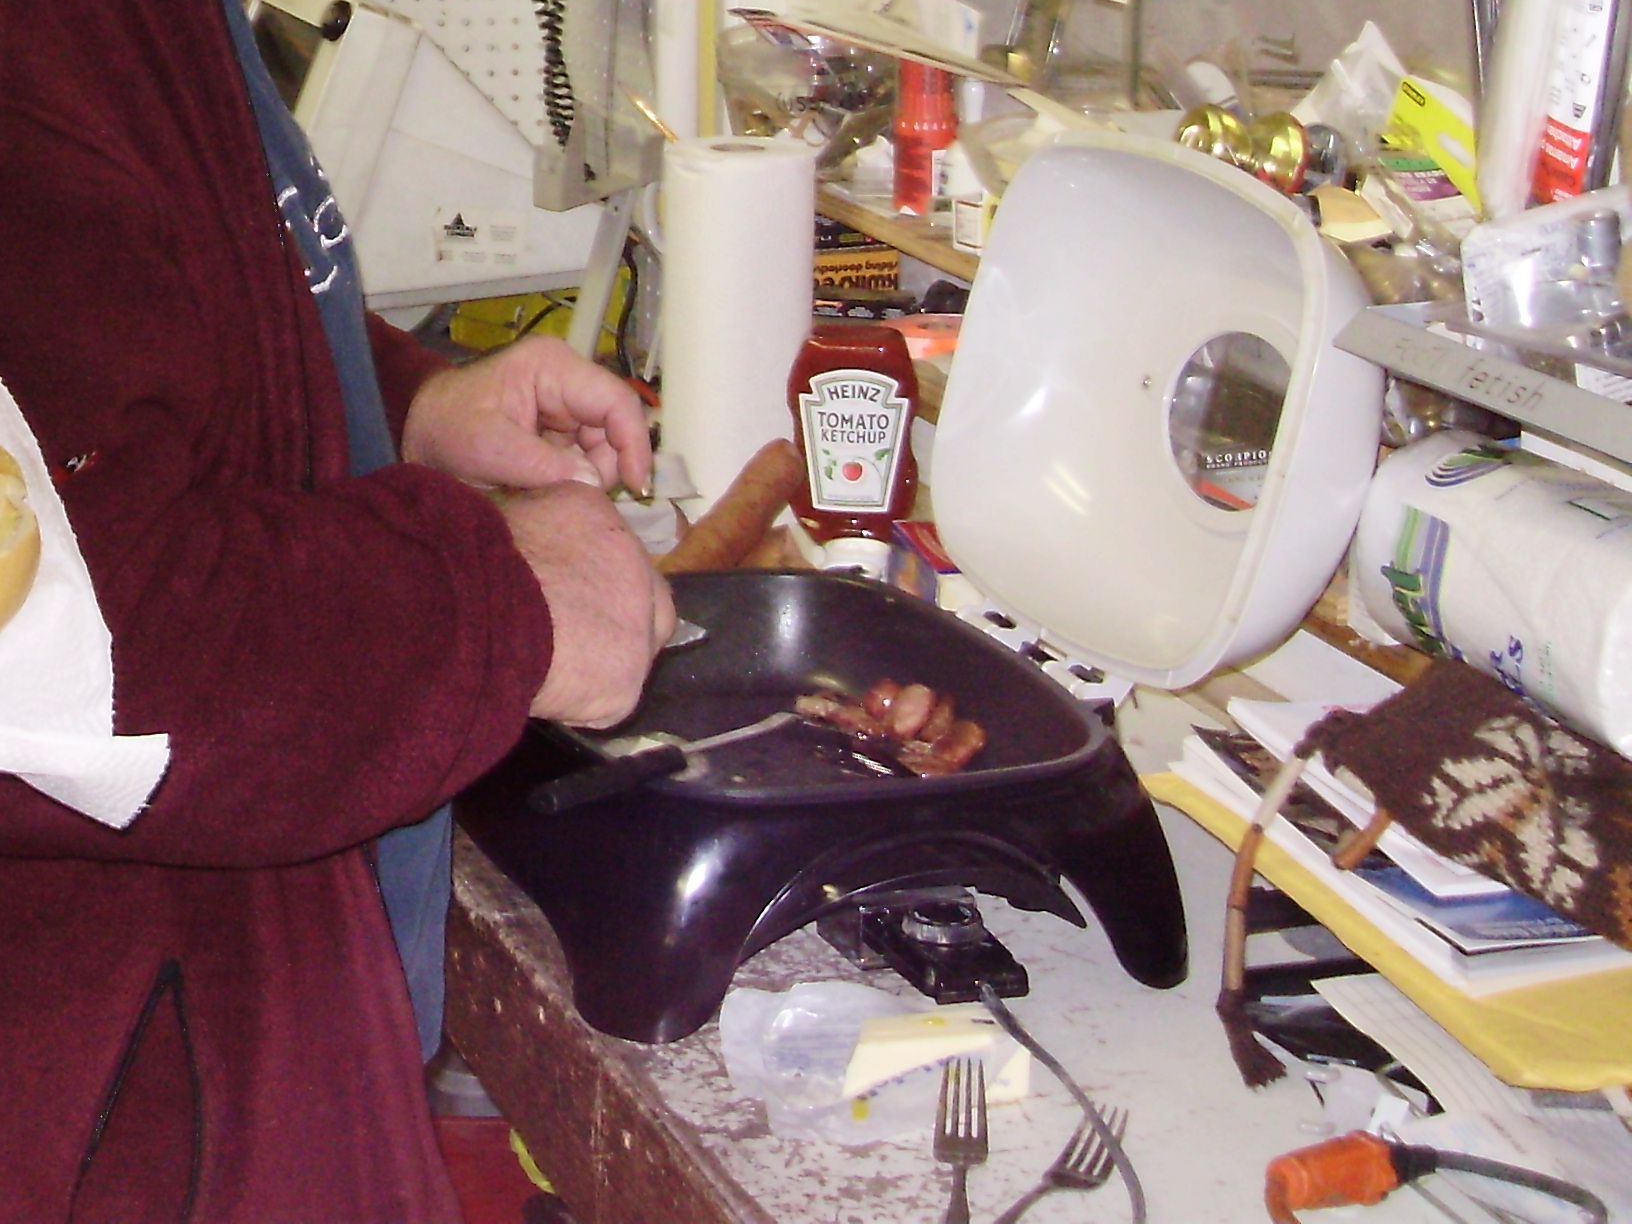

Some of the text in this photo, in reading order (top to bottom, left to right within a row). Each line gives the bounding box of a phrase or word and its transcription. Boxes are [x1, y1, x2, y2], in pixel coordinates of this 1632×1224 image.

[826, 384, 881, 403] HEINZ
[1459, 358, 1545, 411] fetish
[817, 411, 890, 431] TOMATO
[820, 428, 887, 444] KETCHUP
